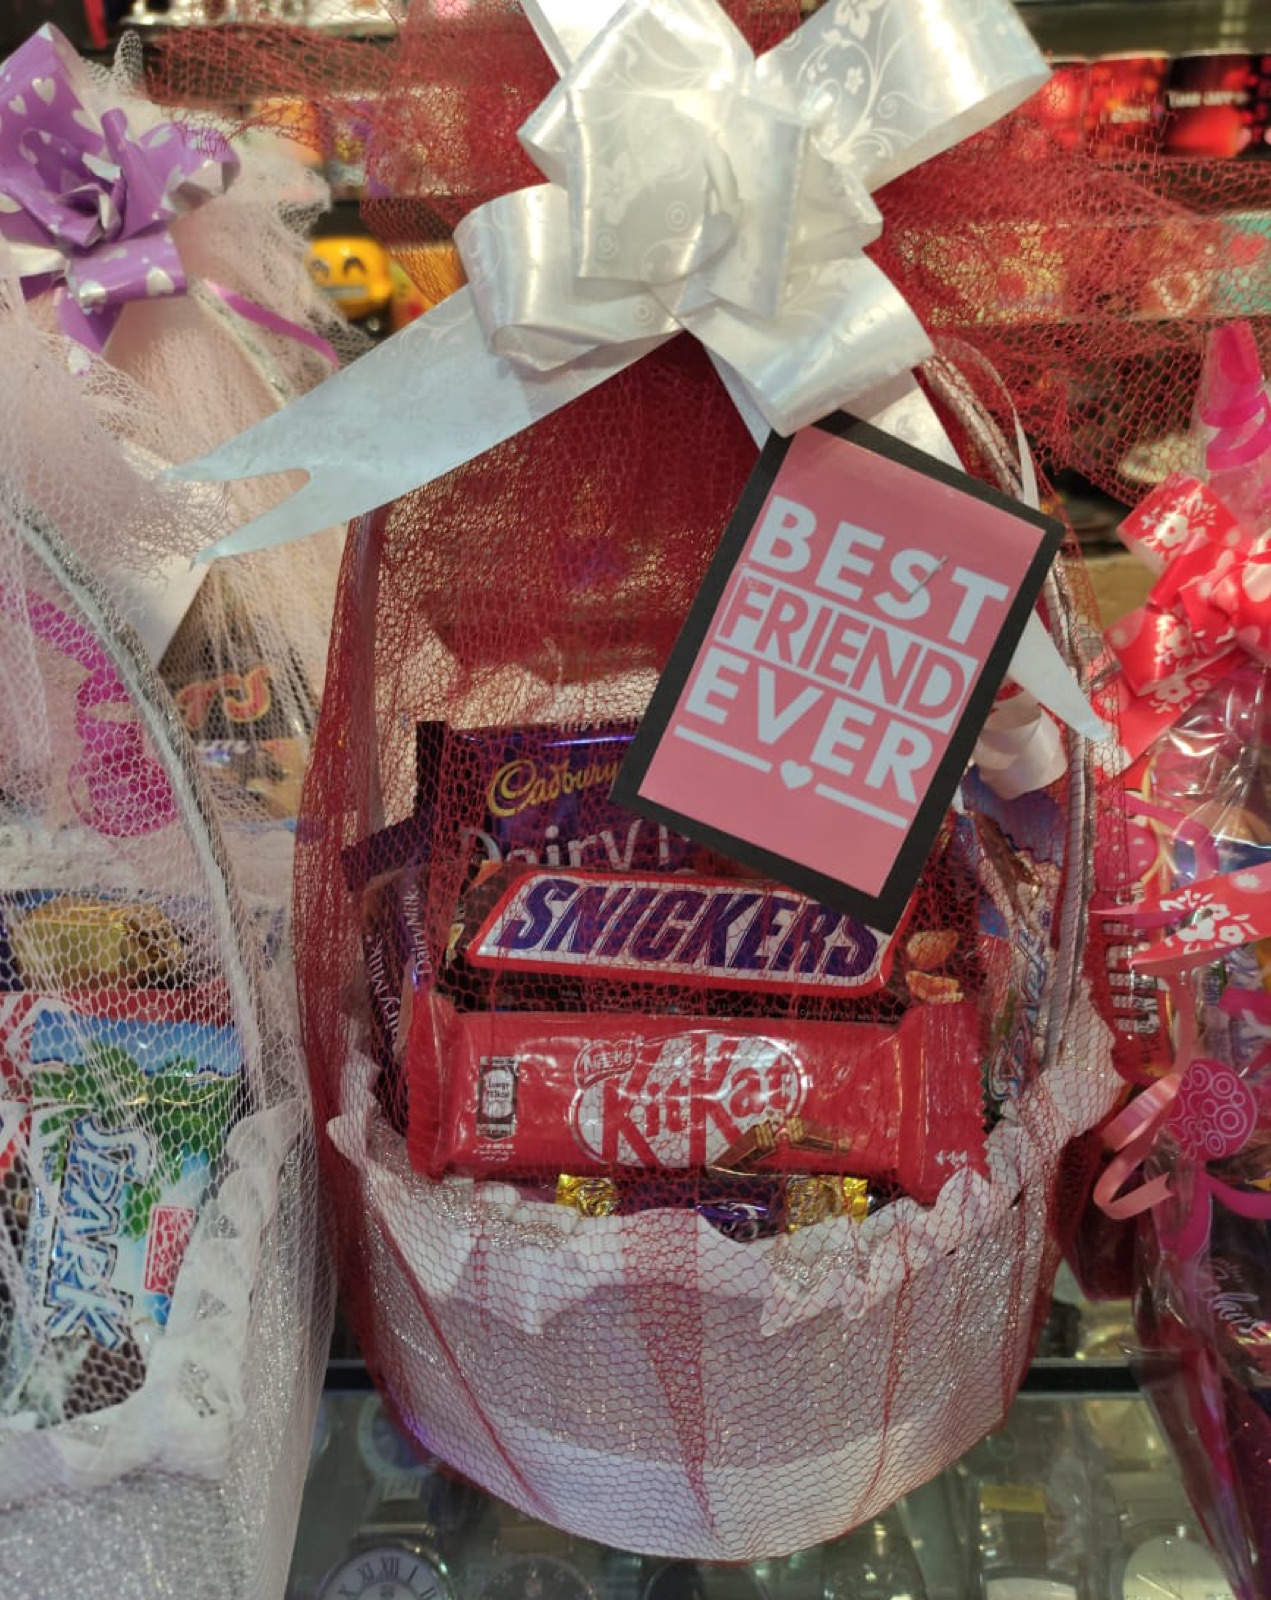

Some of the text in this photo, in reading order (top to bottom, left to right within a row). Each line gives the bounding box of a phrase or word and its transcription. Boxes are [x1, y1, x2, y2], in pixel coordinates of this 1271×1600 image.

[750, 496, 1010, 645] BEST
[720, 576, 966, 720] FRIEND
[488, 759, 622, 817] Cadbury
[684, 648, 934, 804] EVER
[497, 878, 879, 978] SNICKERS
